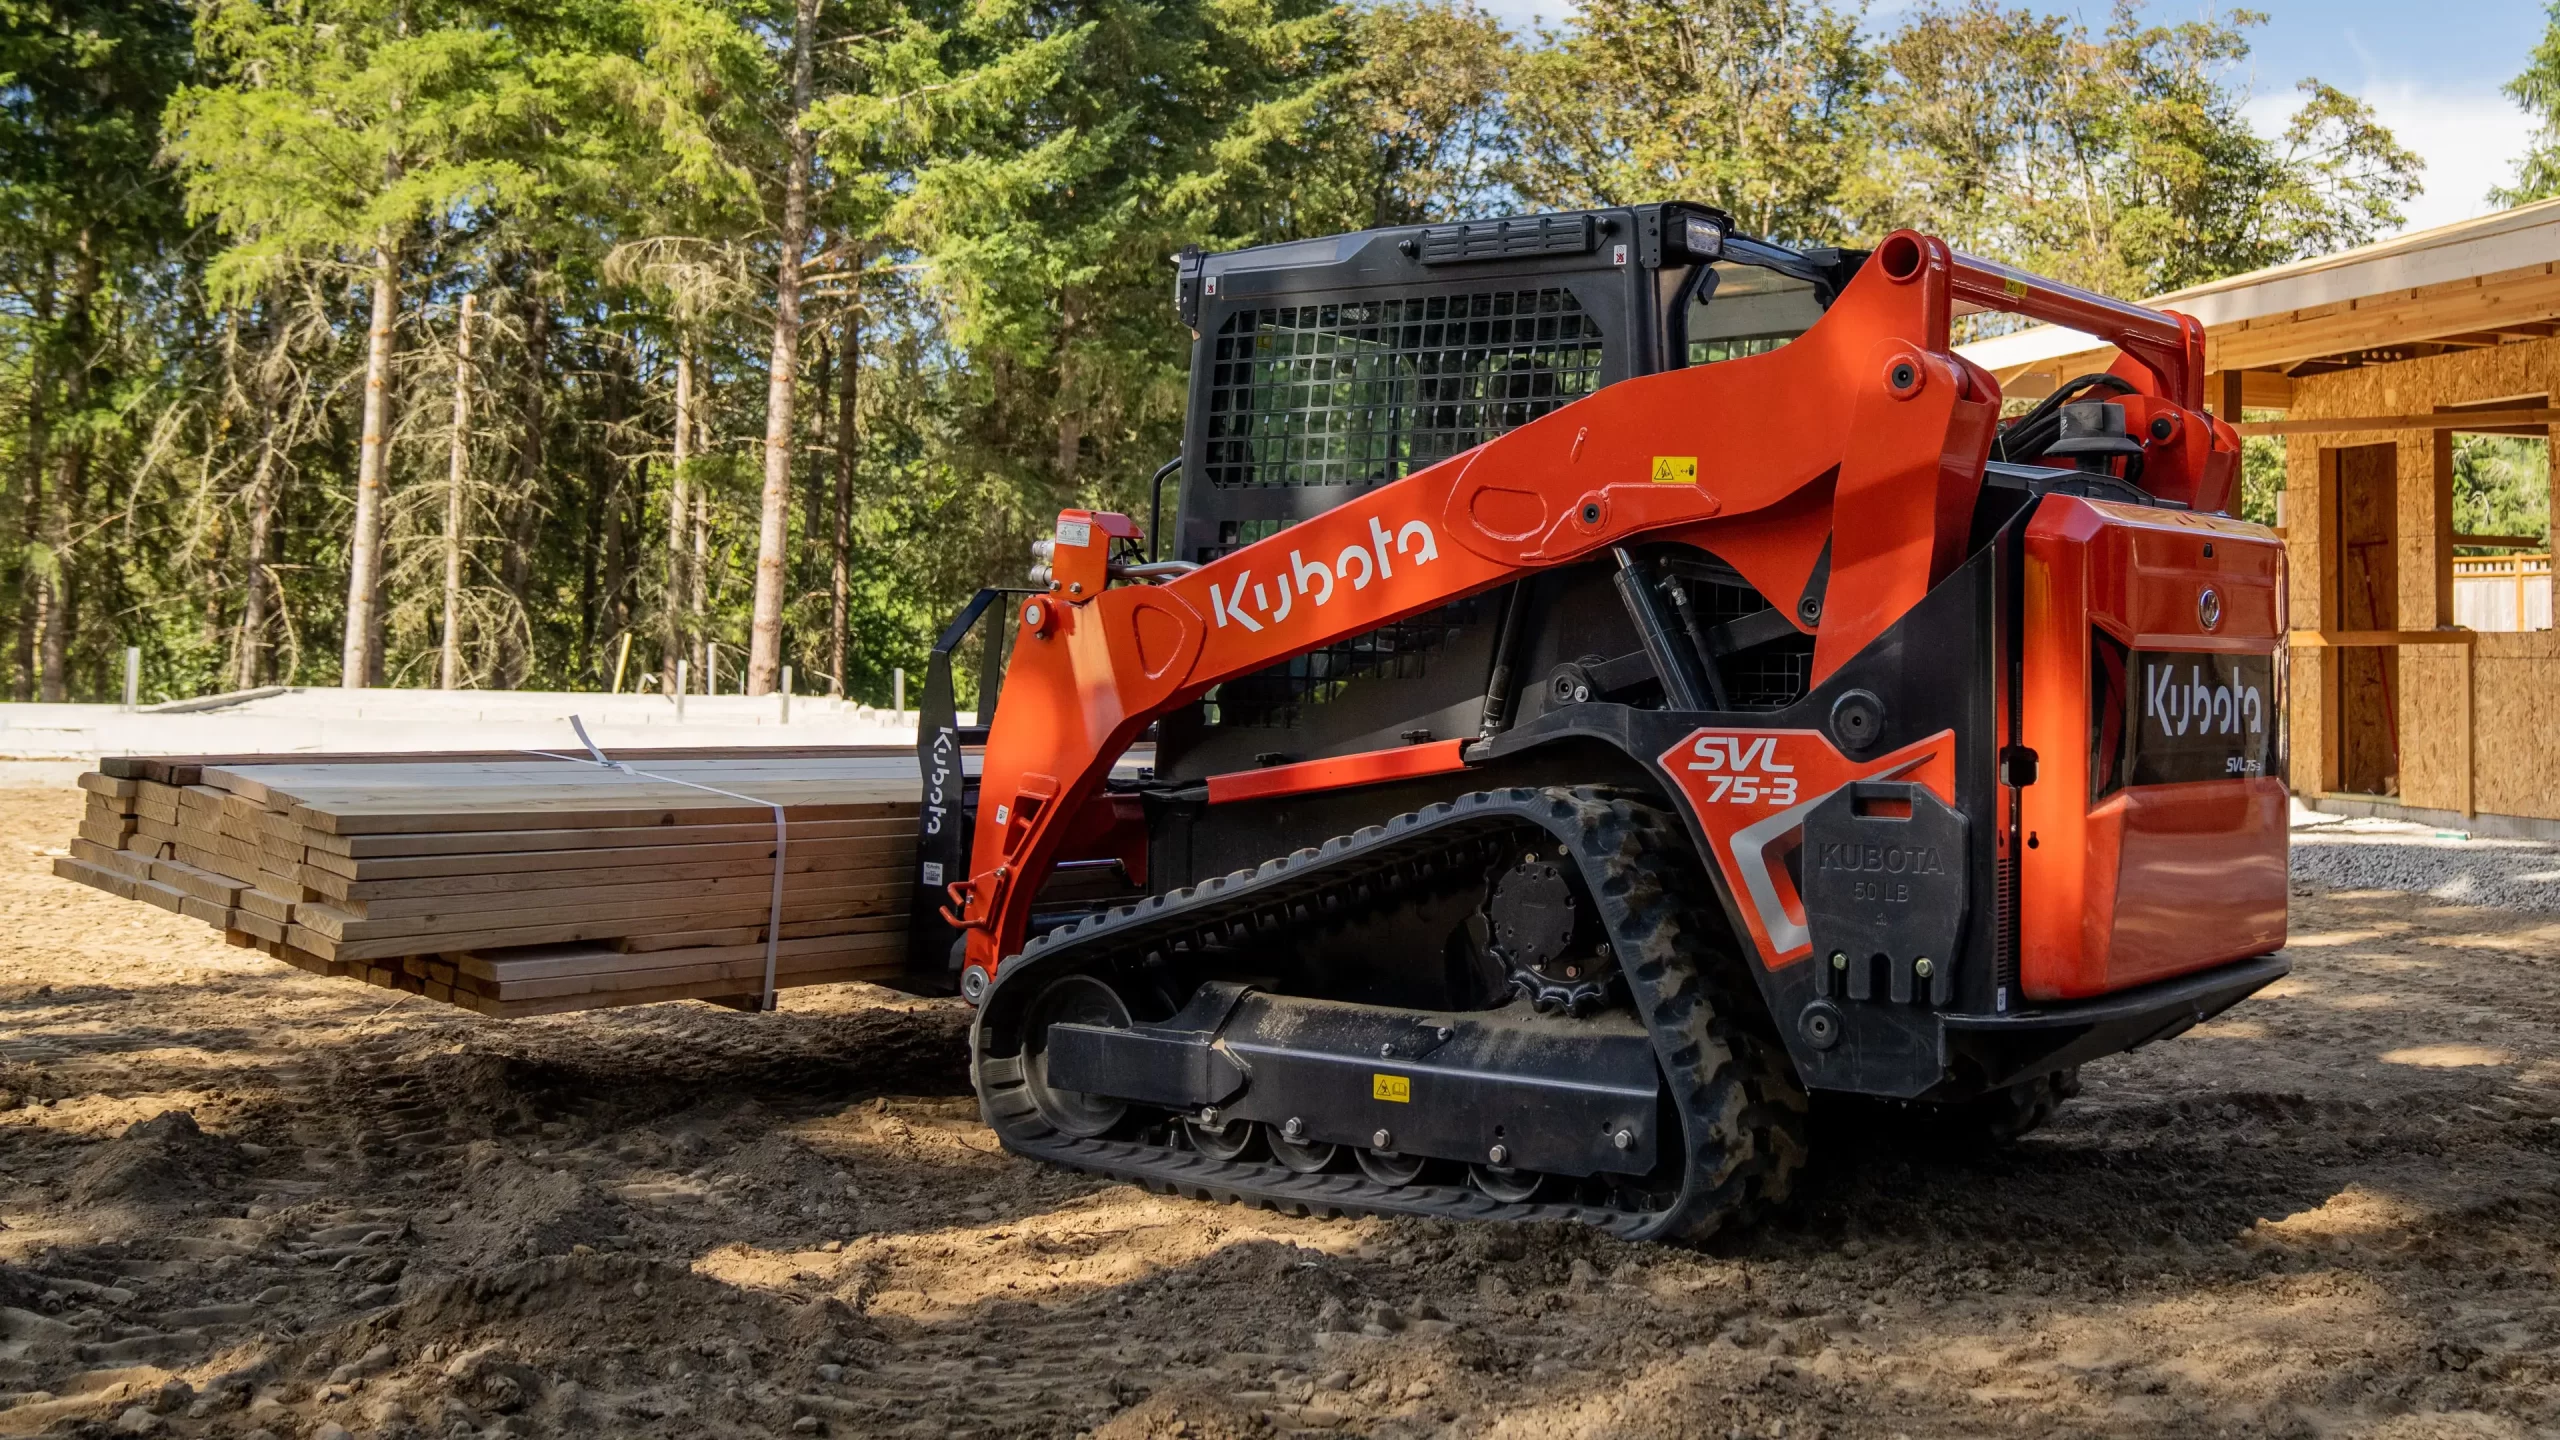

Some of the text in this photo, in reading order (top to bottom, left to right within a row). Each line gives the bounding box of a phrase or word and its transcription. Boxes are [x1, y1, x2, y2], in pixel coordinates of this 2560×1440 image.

[1209, 516, 1439, 632] Kubota
[2147, 664, 2261, 736] Kubota
[1687, 736, 1795, 773] SVL
[927, 726, 953, 834] Kubota
[1706, 775, 1798, 805] 75-3
[1819, 842, 1945, 875] KUBOTA
[1854, 881, 1909, 903] 50 LB
